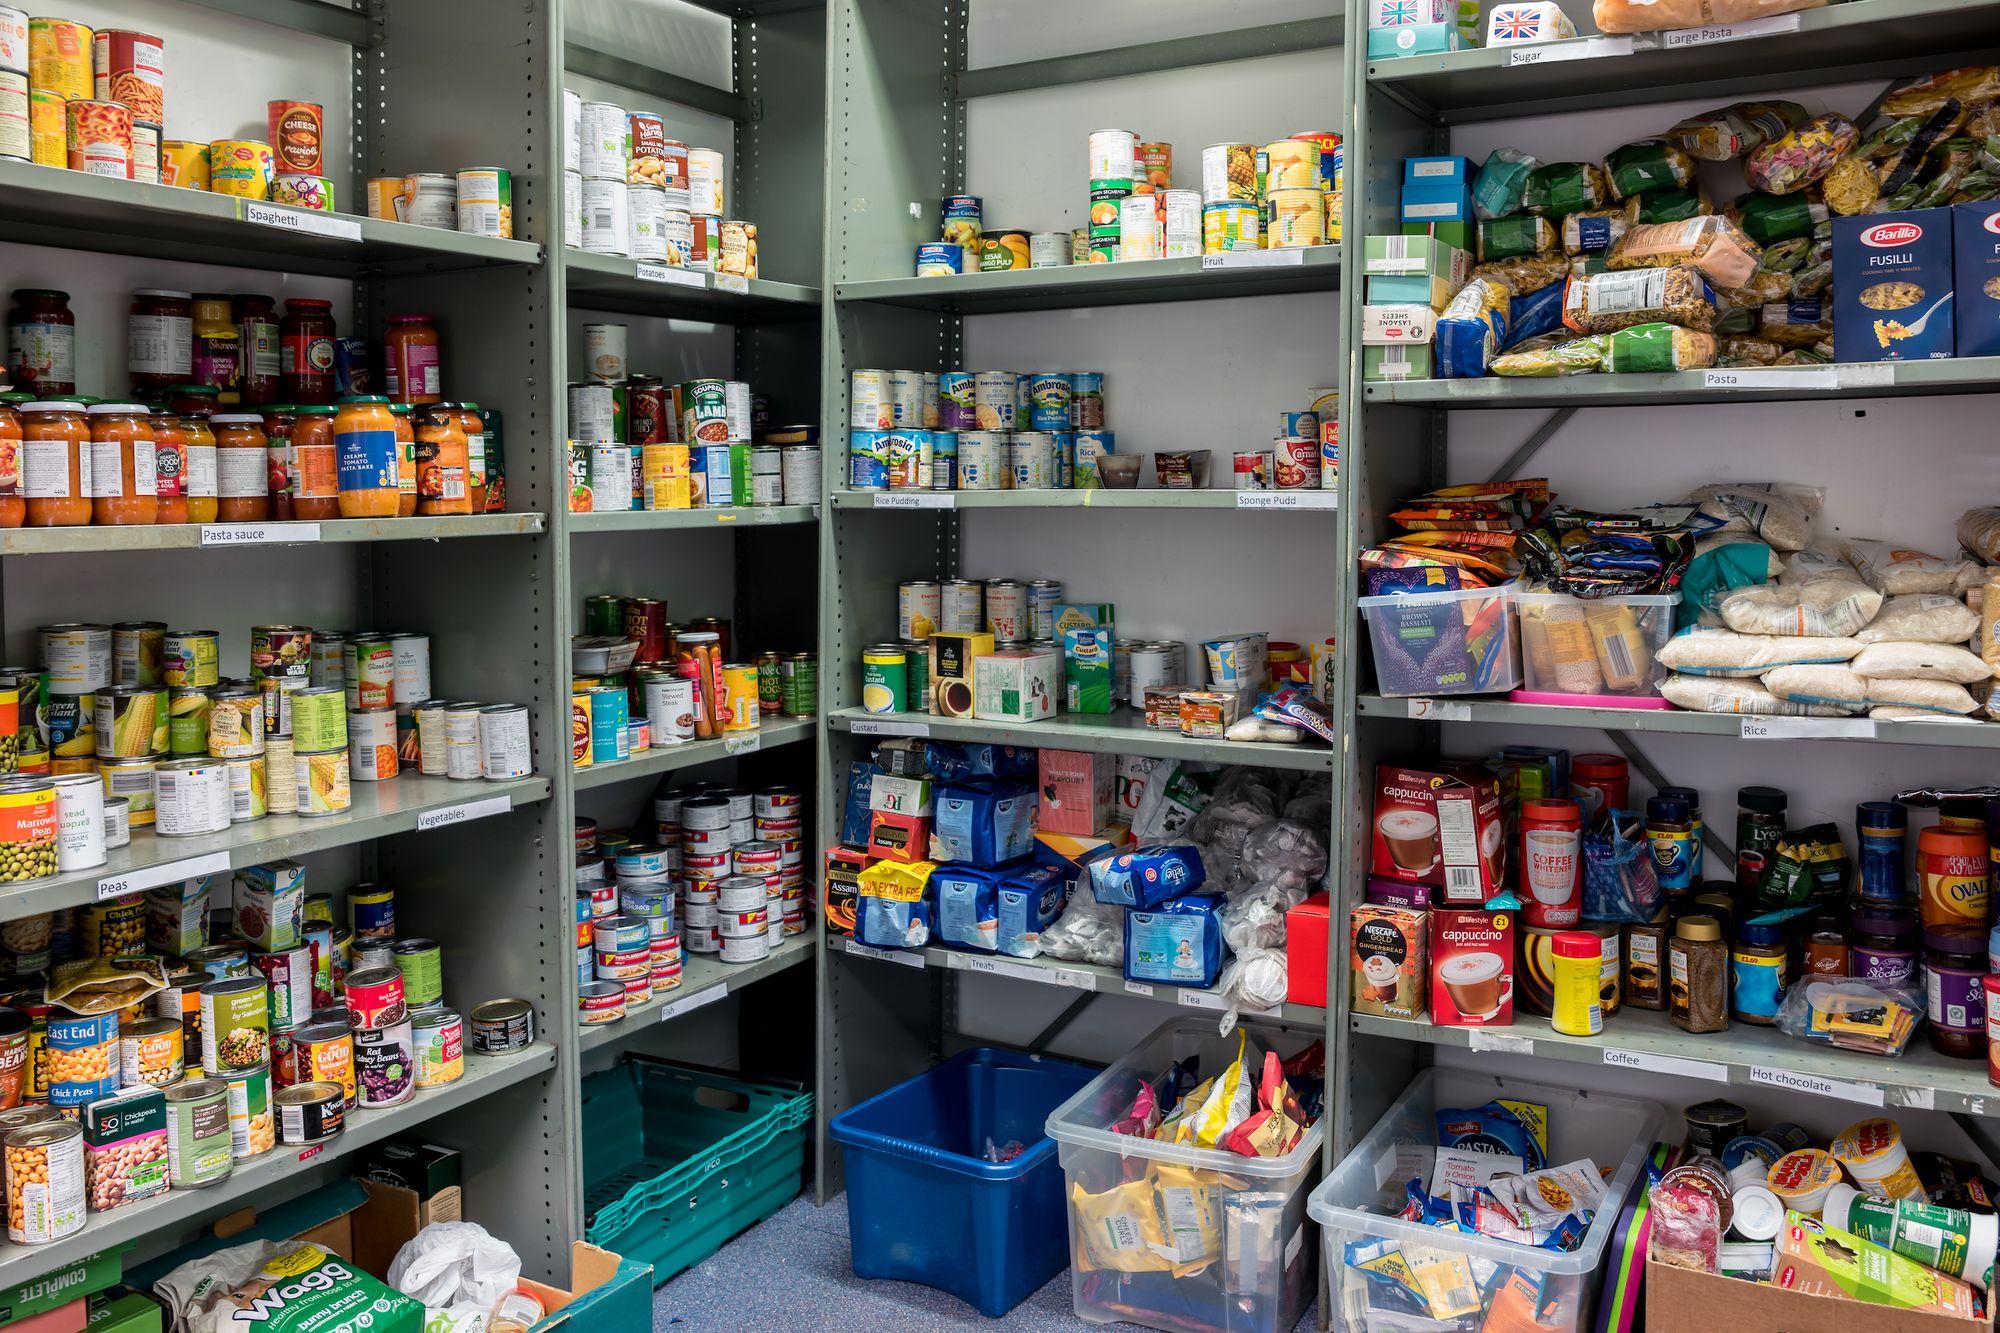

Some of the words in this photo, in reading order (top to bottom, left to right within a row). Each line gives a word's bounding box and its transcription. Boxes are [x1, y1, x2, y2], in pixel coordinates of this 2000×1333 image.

[1669, 33, 1698, 46] Large
[1702, 28, 1732, 40] Pasta
[1513, 51, 1541, 63] Sugar
[284, 120, 317, 132] CHEESE
[250, 208, 298, 226] Spaghetti
[1873, 226, 1916, 242] Barilla
[1204, 257, 1224, 266] Fruit
[1869, 253, 1913, 266] FUSILLI
[638, 267, 666, 279] Potatoes
[1930, 352, 1944, 360] 500g
[1707, 374, 1737, 385] Pasta
[1033, 380, 1071, 394] Ambrosia
[696, 405, 727, 419] LAMB
[1080, 448, 1096, 456] Rice
[159, 459, 179, 467] FOOD
[875, 497, 889, 505] Rice
[891, 497, 920, 506] Pudding
[1239, 496, 1271, 506] Sponge
[1273, 496, 1296, 504] Pudd
[204, 531, 232, 540] Pasta
[235, 531, 265, 540] sauce
[1401, 612, 1428, 620] BROWN
[1059, 622, 1091, 630] CUSTARD
[1400, 619, 1432, 627] BASMATI
[1075, 646, 1098, 654] Custard
[761, 677, 780, 686] HOT
[760, 686, 782, 694] DOGS
[852, 724, 878, 732] Custard
[1744, 725, 1767, 736] Rice
[1048, 776, 1085, 784] FLAVOUR?
[1116, 774, 1146, 809] PG
[1384, 786, 1434, 801] cappuccin
[64, 808, 85, 818] peas
[418, 809, 465, 827] Vegetables
[60, 818, 90, 830] garden
[32, 826, 52, 837] Peas
[63, 834, 89, 843] savers
[876, 838, 893, 846] Assam
[1533, 853, 1572, 865] COFFEE
[1533, 862, 1572, 873] WHITENER
[1949, 855, 1973, 876] 33%
[1165, 865, 1186, 880] Tetley
[100, 880, 128, 895] Peas
[831, 882, 857, 893] Assam
[879, 881, 903, 896] EXTRA
[1039, 888, 1057, 909] Tetley
[109, 908, 134, 919] Chick
[1465, 916, 1489, 924] lifestyle
[1496, 918, 1506, 926] £1
[1370, 934, 1393, 943] GOLD
[1442, 929, 1502, 942] cappuccino
[846, 943, 880, 957] Speciality
[880, 949, 893, 959] Tea
[1359, 942, 1404, 954] GINGERBREAD
[1634, 941, 1655, 949] GOLD
[971, 959, 995, 971] Treats
[1867, 960, 1914, 979] Stockwell
[1184, 994, 1200, 1004] Tea
[662, 1007, 675, 1017] Fish
[71, 1024, 95, 1039] End
[143, 1040, 172, 1054] GOOD
[366, 1048, 382, 1056] Red
[317, 1045, 349, 1063] GOOD
[376, 1052, 400, 1063] Beans
[1605, 1051, 1640, 1066] Coffee
[1752, 1068, 1772, 1080] Hot
[1776, 1072, 1832, 1092] chocolate
[51, 1087, 71, 1097] Chick
[73, 1087, 93, 1097] Peas
[125, 1108, 157, 1121] Chickpeas
[100, 1118, 119, 1131] SO
[1518, 1111, 1540, 1137] MINUTES
[100, 1128, 119, 1137] organic
[1447, 1162, 1475, 1172] Tomato
[1451, 1172, 1476, 1180] Onion
[1115, 1219, 1127, 1246] CURLS
[1120, 1215, 1135, 1246] CHEESE
[1385, 1262, 1406, 1276] COOKS
[1386, 1258, 1405, 1269] NOW
[20, 1267, 86, 1304] COMPLETE
[232, 1261, 355, 1322] Wagg
[268, 1303, 300, 1331] Healthy
[299, 1293, 323, 1305] from
[321, 1285, 343, 1298] nose
[390, 1294, 409, 1312] 2kg
[297, 1306, 331, 1331] bunny
[331, 1289, 366, 1309] brunch
